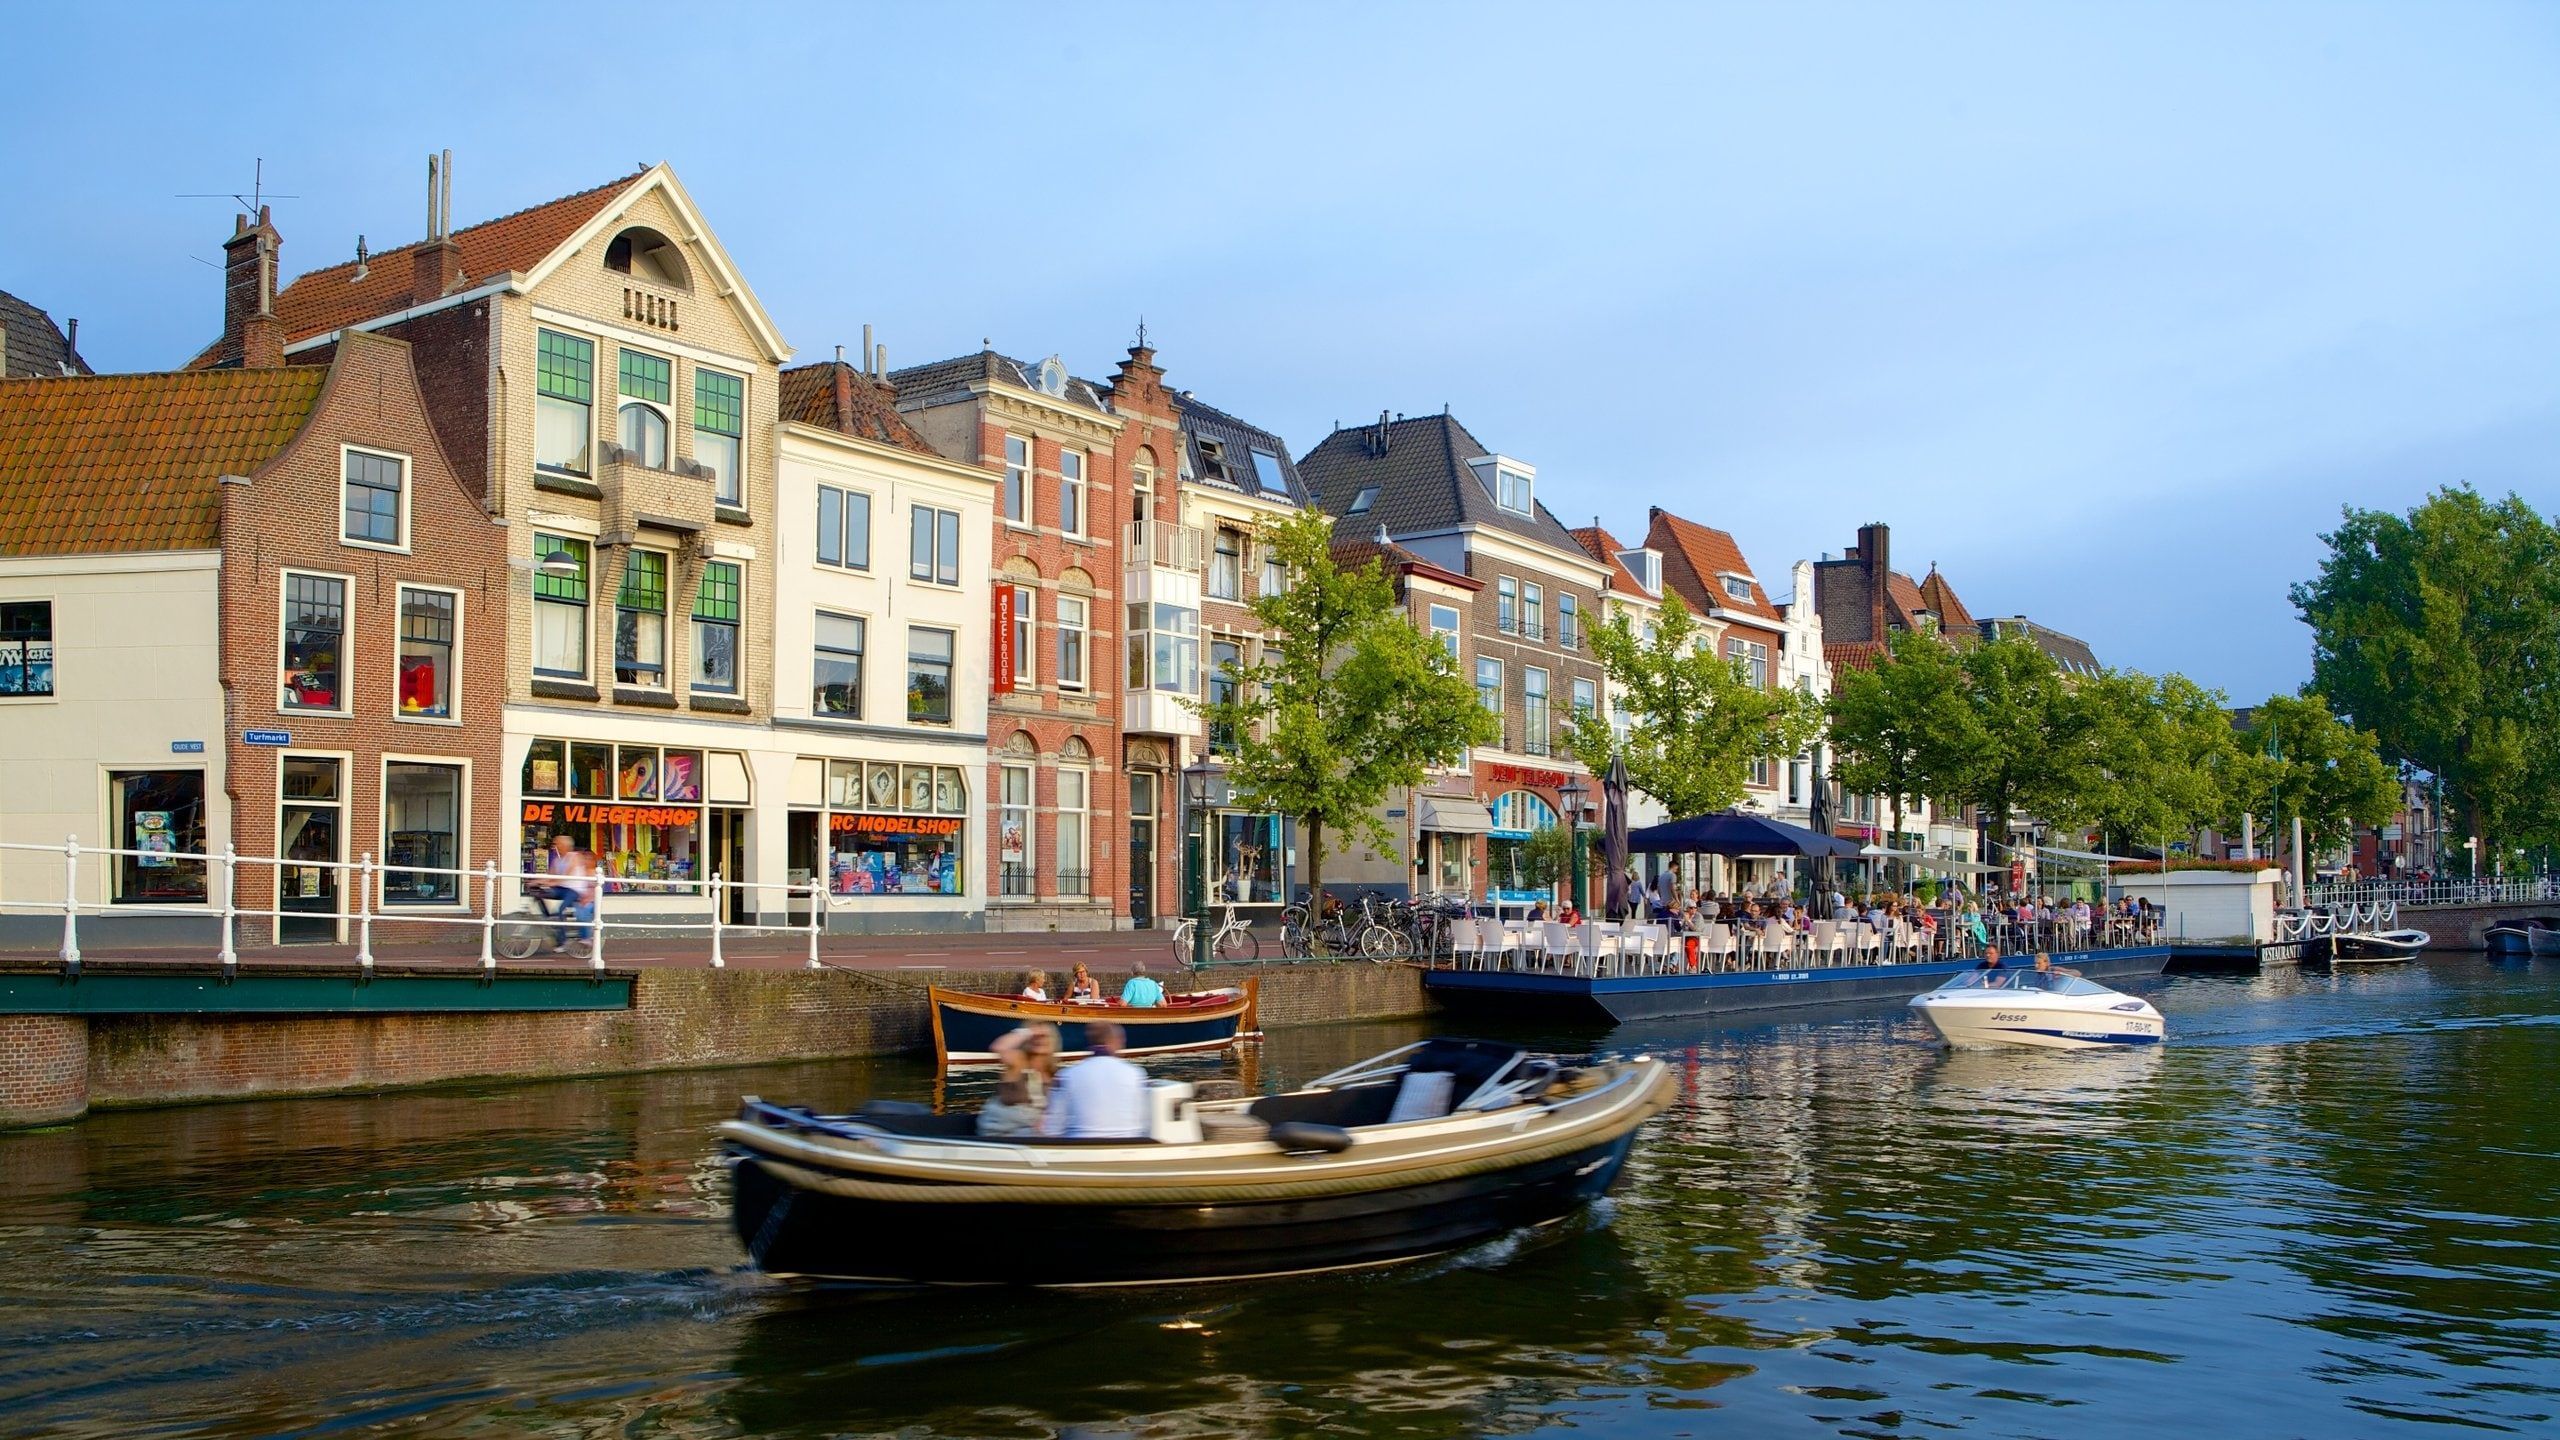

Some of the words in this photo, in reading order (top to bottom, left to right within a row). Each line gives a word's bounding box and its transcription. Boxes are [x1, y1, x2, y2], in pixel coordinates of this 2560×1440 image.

[249, 733, 287, 742] Turfmarkt
[173, 743, 188, 751] OUDE
[523, 804, 555, 822] DE
[564, 805, 698, 826] VLIEGERSHOP
[830, 815, 855, 830] RC
[857, 816, 960, 834] MODELSHOP
[1991, 1012, 2027, 1022] Jesse
